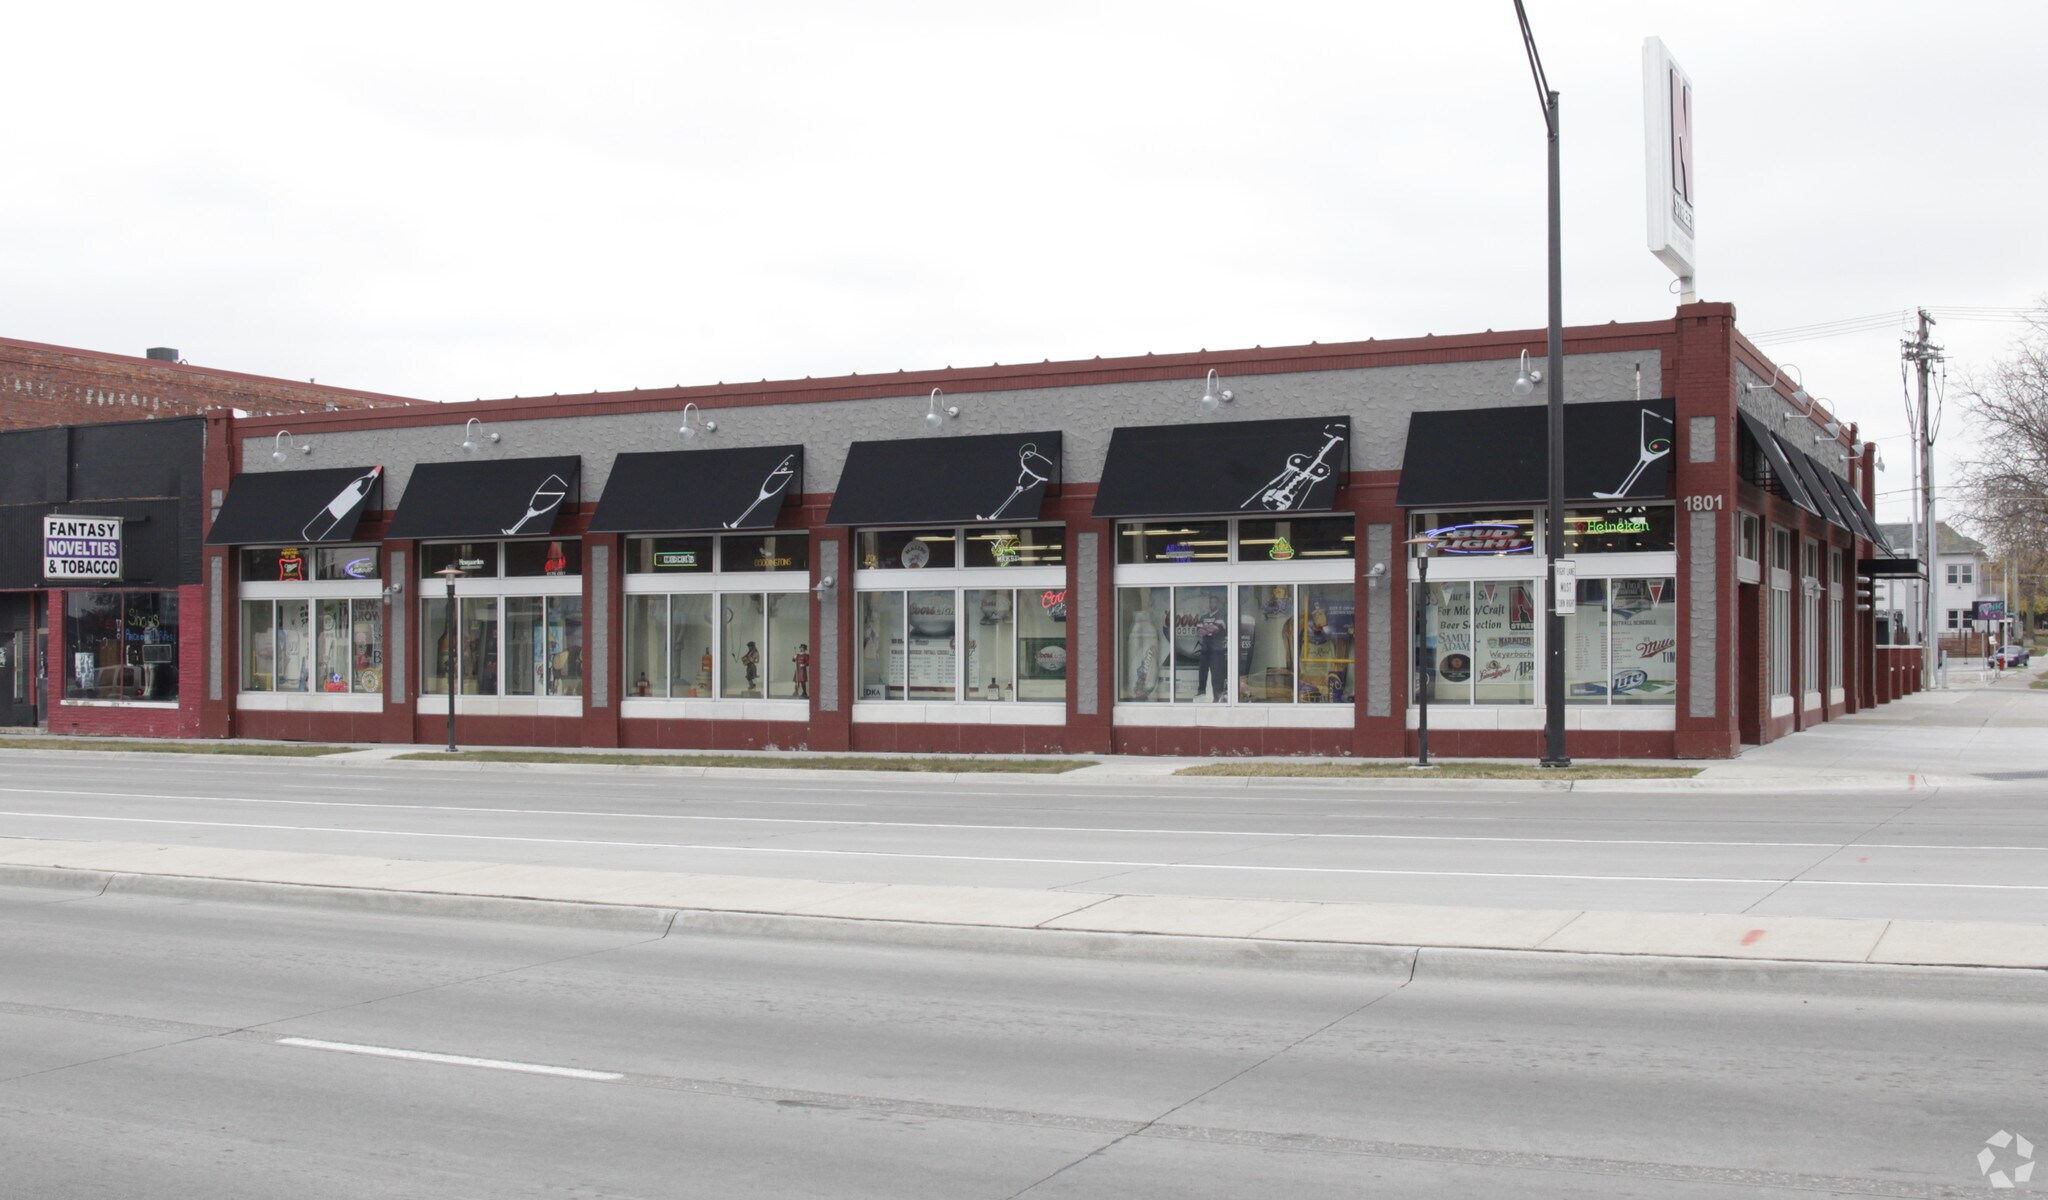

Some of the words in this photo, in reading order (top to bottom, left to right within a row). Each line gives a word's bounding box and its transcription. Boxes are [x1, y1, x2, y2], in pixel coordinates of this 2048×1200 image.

[1684, 495, 1723, 511] 1801
[49, 521, 115, 537] FANTASY
[1587, 520, 1650, 532] Heineken
[1450, 528, 1517, 540] BUD
[48, 540, 117, 556] NOVELTIES
[1435, 538, 1526, 550] LIGHT
[48, 559, 57, 573] &
[61, 560, 118, 574] TOBACCO
[1560, 582, 1572, 592] MUST
[1041, 591, 1066, 608] Coo
[1438, 605, 1451, 616] For
[1453, 604, 1505, 617] Mico/Craft
[1440, 621, 1460, 630] Beer
[1462, 619, 1502, 630] Seection
[1441, 642, 1478, 652] ADAM
[1635, 637, 1676, 658] Mille
[1662, 652, 1676, 663] TIM
